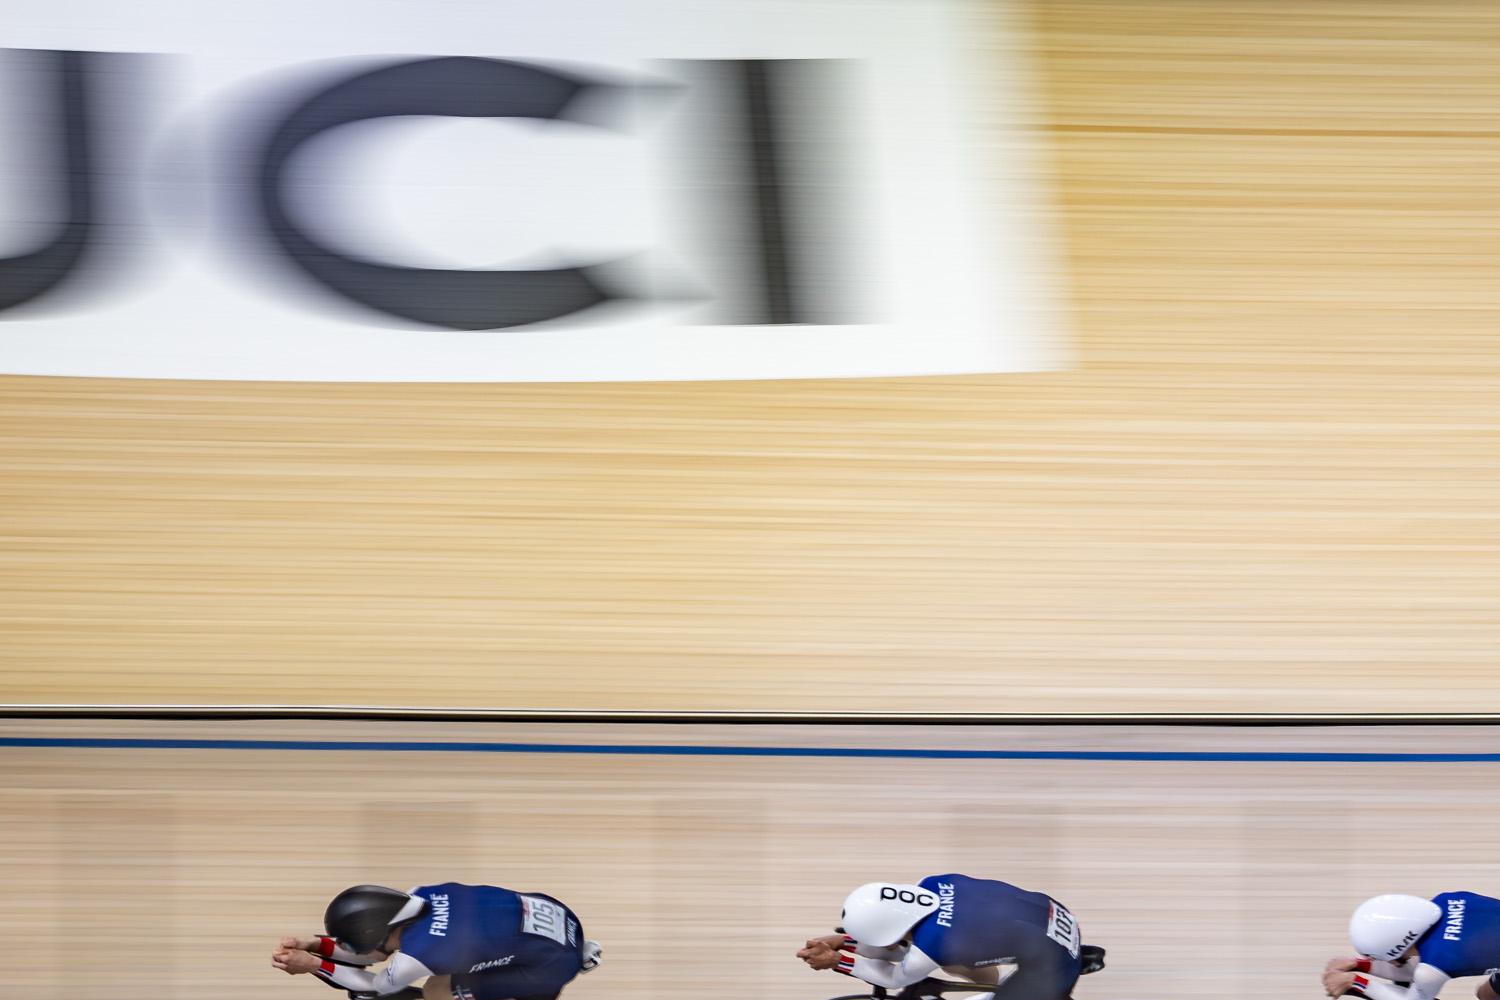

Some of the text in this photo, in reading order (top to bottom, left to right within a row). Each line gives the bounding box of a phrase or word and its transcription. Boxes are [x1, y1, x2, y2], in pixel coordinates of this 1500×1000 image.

[429, 893, 450, 936] FRANCE
[532, 901, 555, 934] 105
[936, 882, 955, 928] FRANCE
[1442, 899, 1467, 941] FRANCE
[1054, 908, 1073, 943] 107
[468, 955, 515, 974] FRANCE
